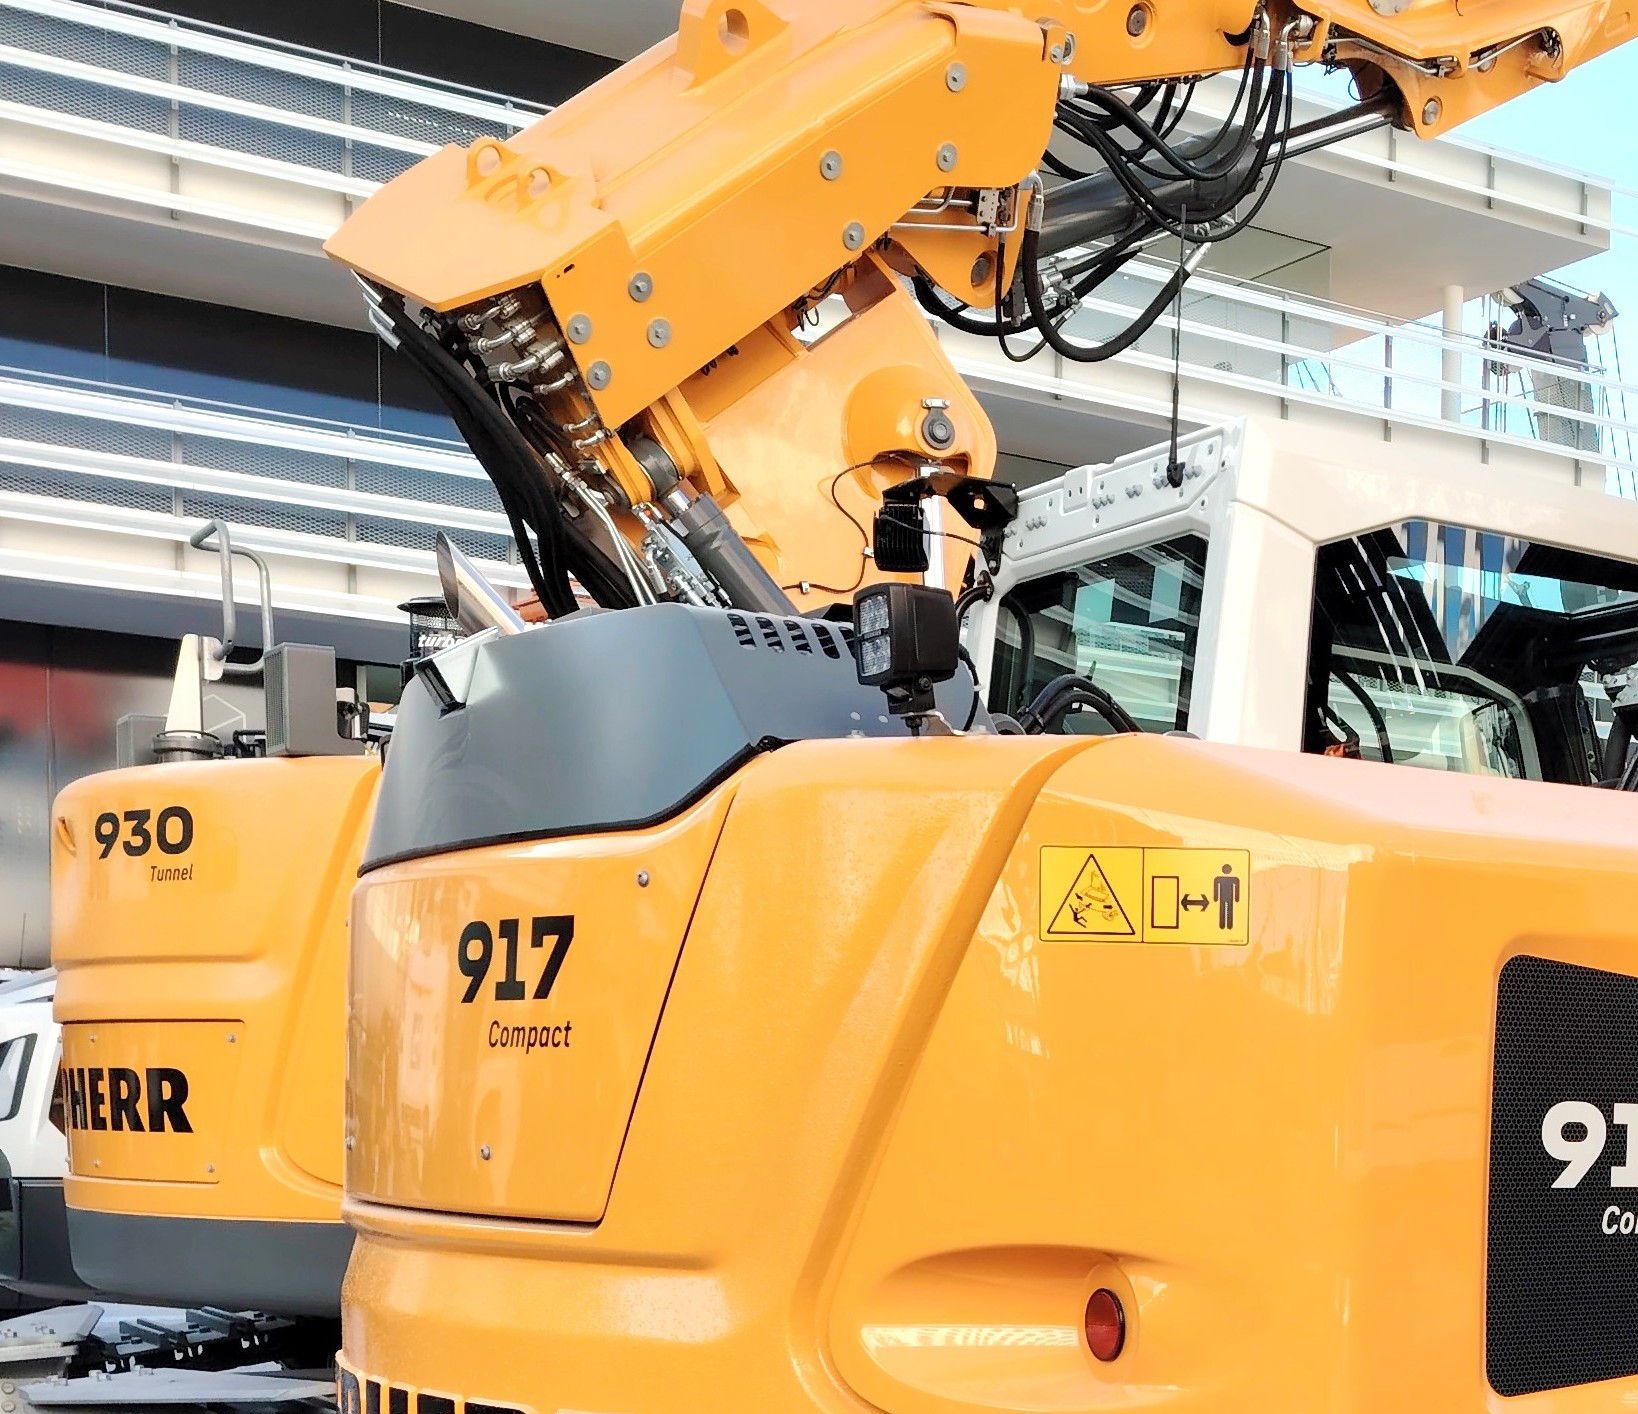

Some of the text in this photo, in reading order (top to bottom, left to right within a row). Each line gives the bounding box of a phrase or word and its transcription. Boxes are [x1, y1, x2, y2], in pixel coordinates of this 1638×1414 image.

[95, 806, 193, 860] 930
[151, 864, 193, 882] Tunnel
[458, 915, 575, 1003] 917
[488, 1020, 572, 1054] Compact
